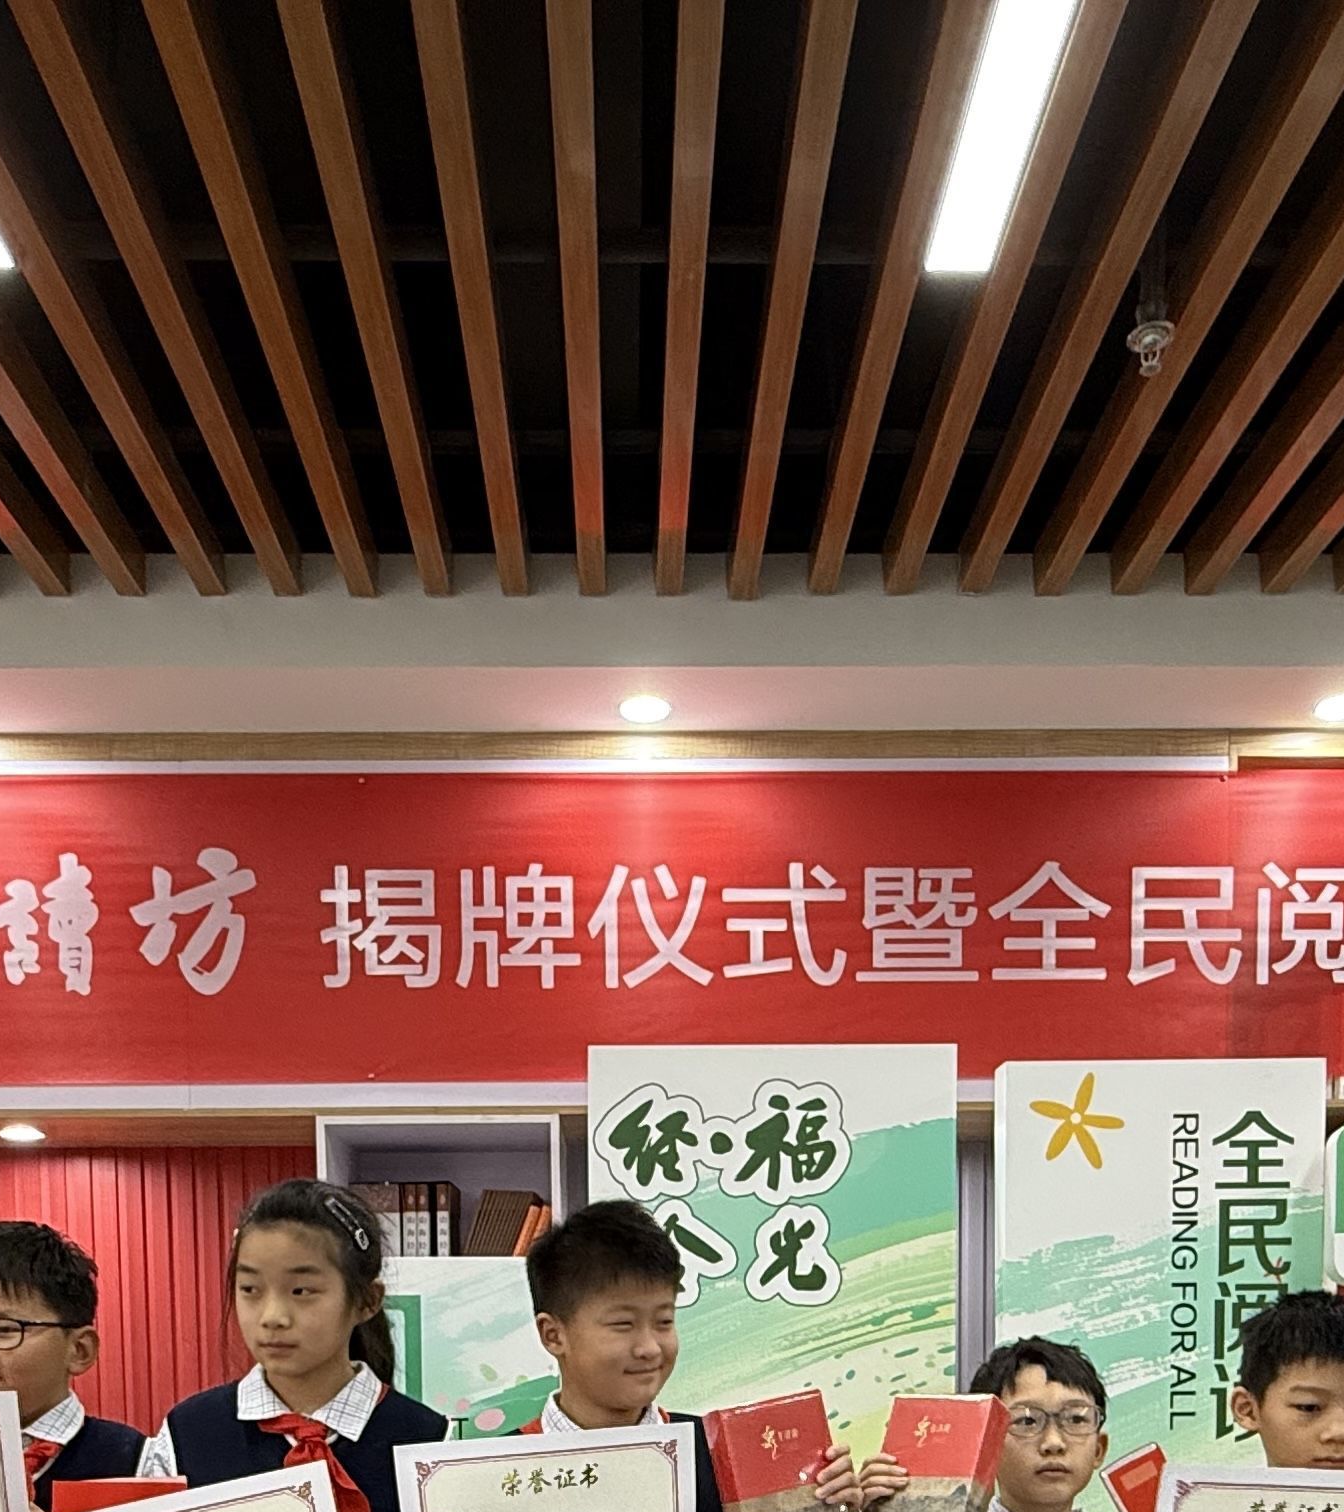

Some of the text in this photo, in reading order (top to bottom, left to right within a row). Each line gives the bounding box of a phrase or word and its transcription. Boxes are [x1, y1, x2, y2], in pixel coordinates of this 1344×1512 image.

[1168, 1112, 1200, 1431] READING FOR ALL
[500, 1462, 600, 1498] 荣誉证书
